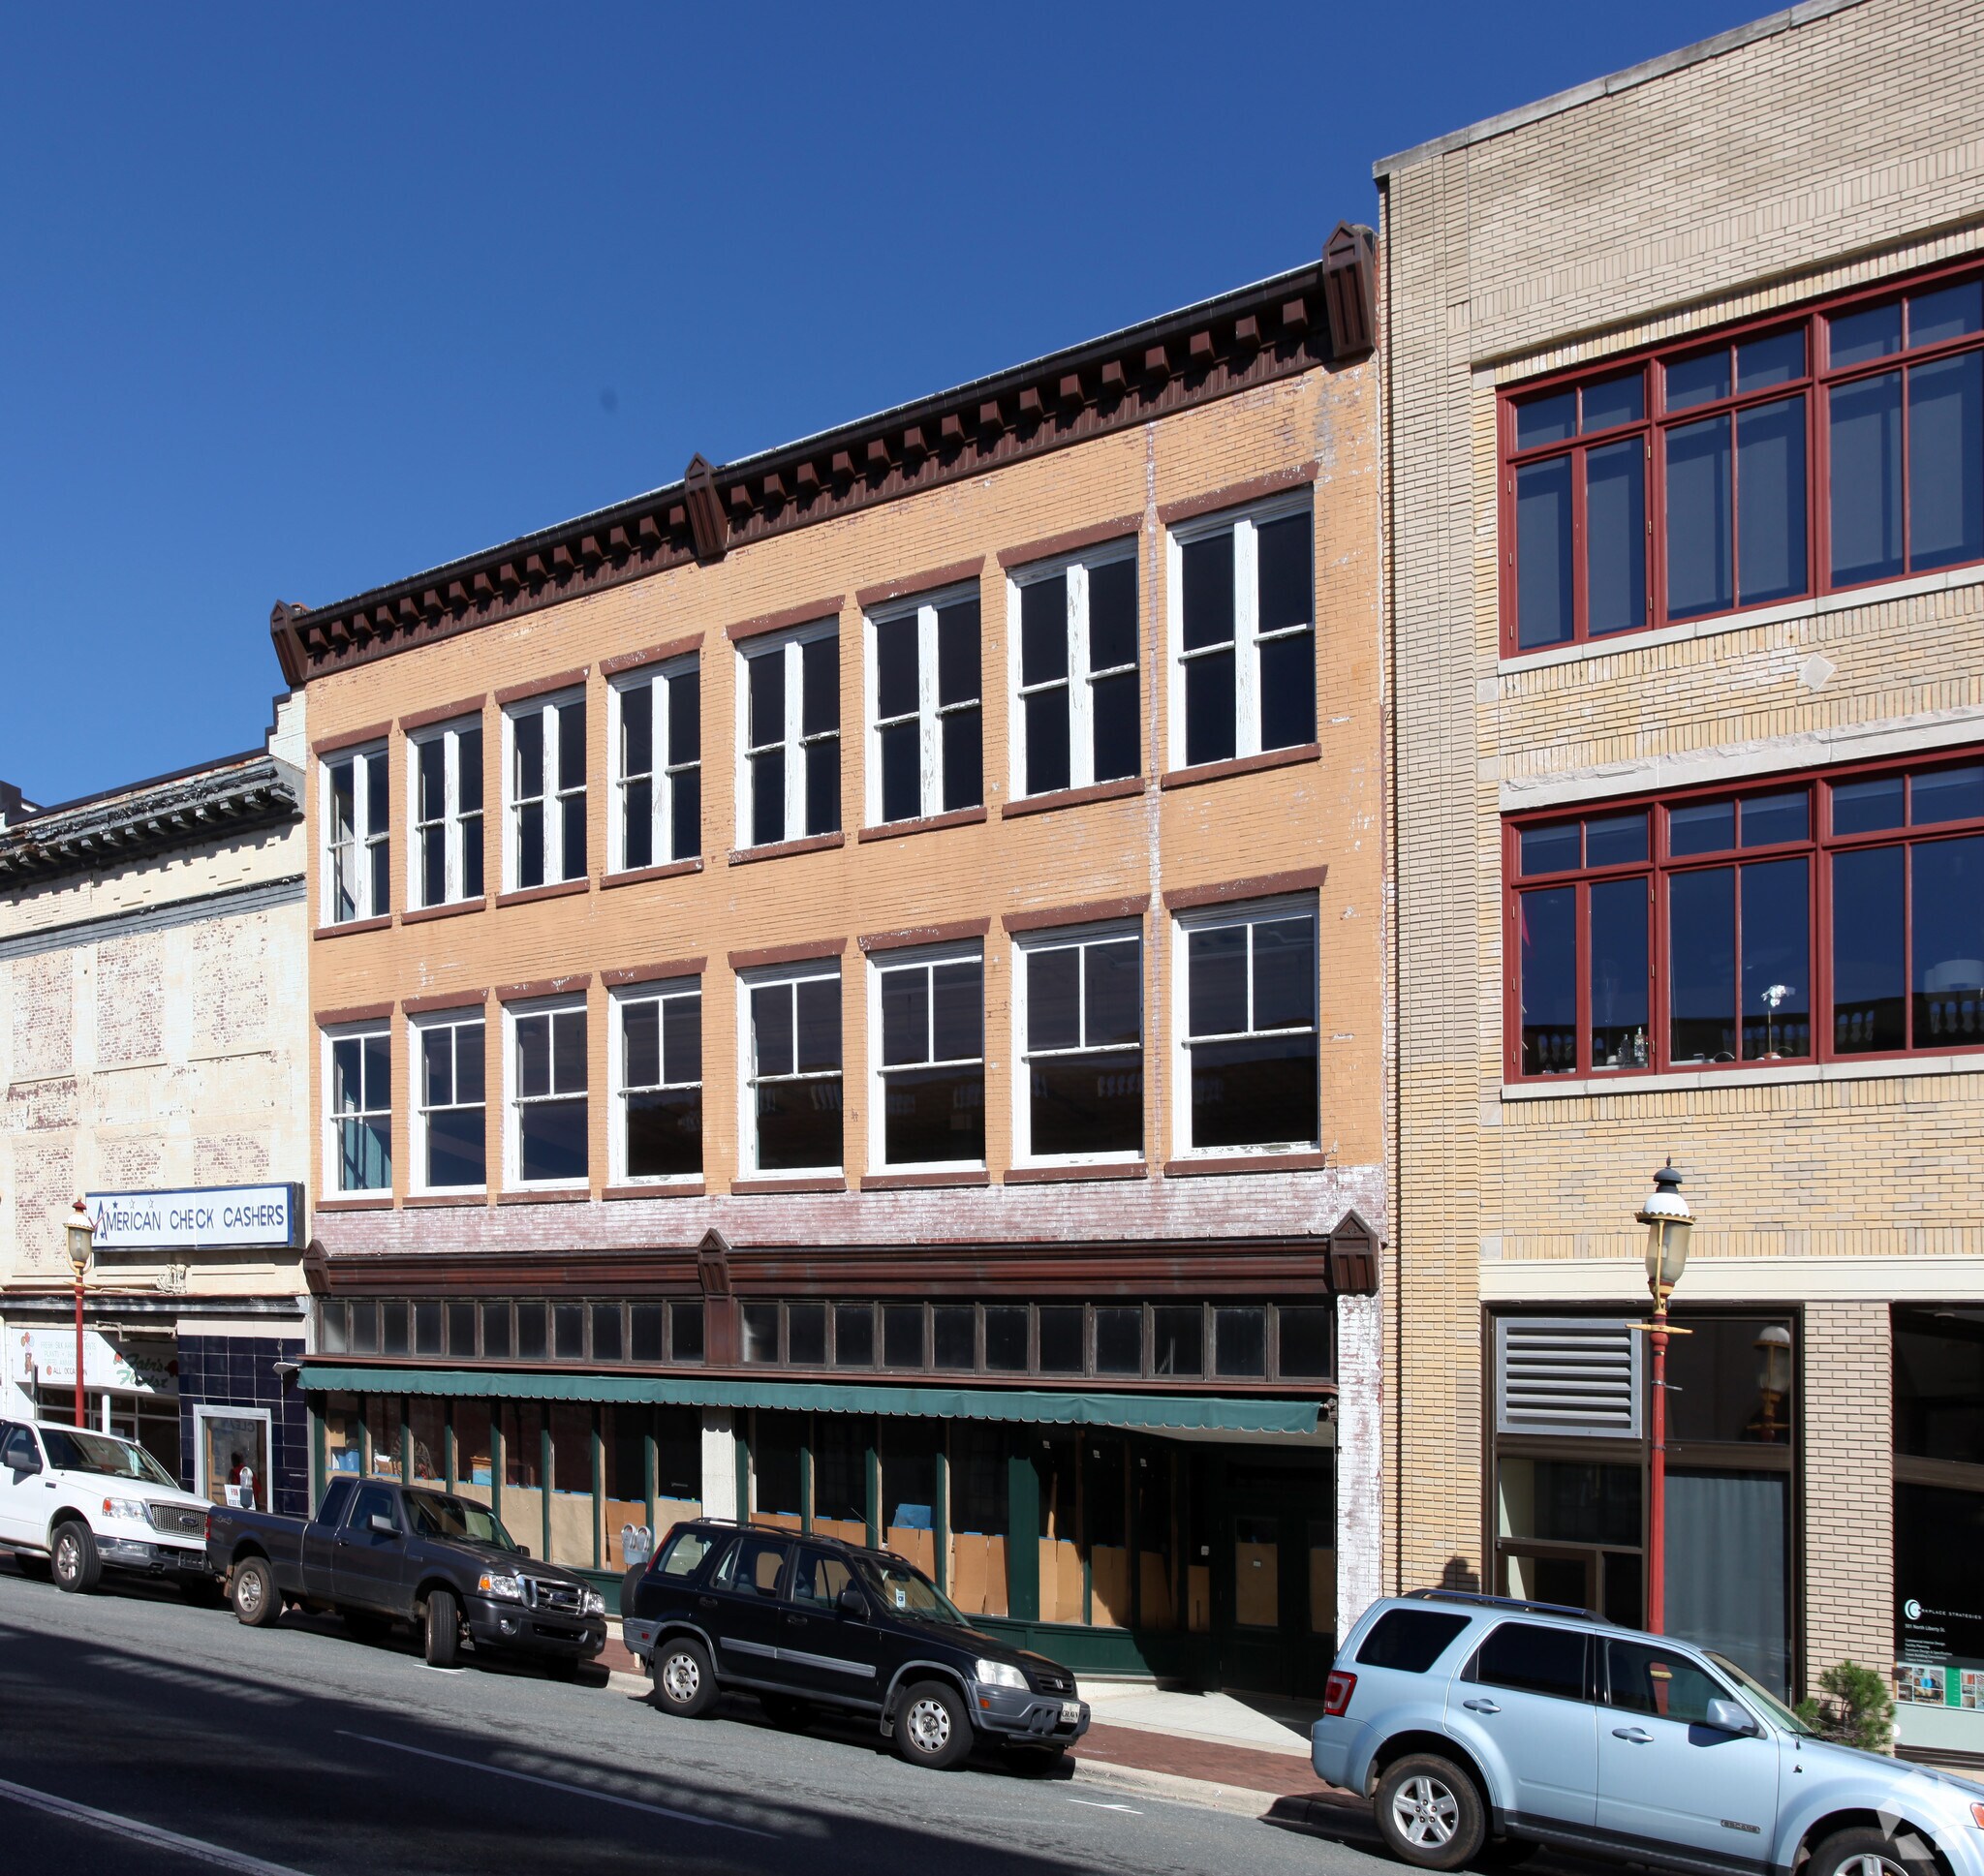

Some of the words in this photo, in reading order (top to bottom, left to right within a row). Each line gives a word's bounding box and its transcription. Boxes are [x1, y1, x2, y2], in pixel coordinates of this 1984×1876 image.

[94, 1200, 161, 1240] AMERICAN
[170, 1208, 214, 1230] CHECK
[223, 1204, 284, 1228] CASHERS
[116, 1369, 169, 1388] Florist
